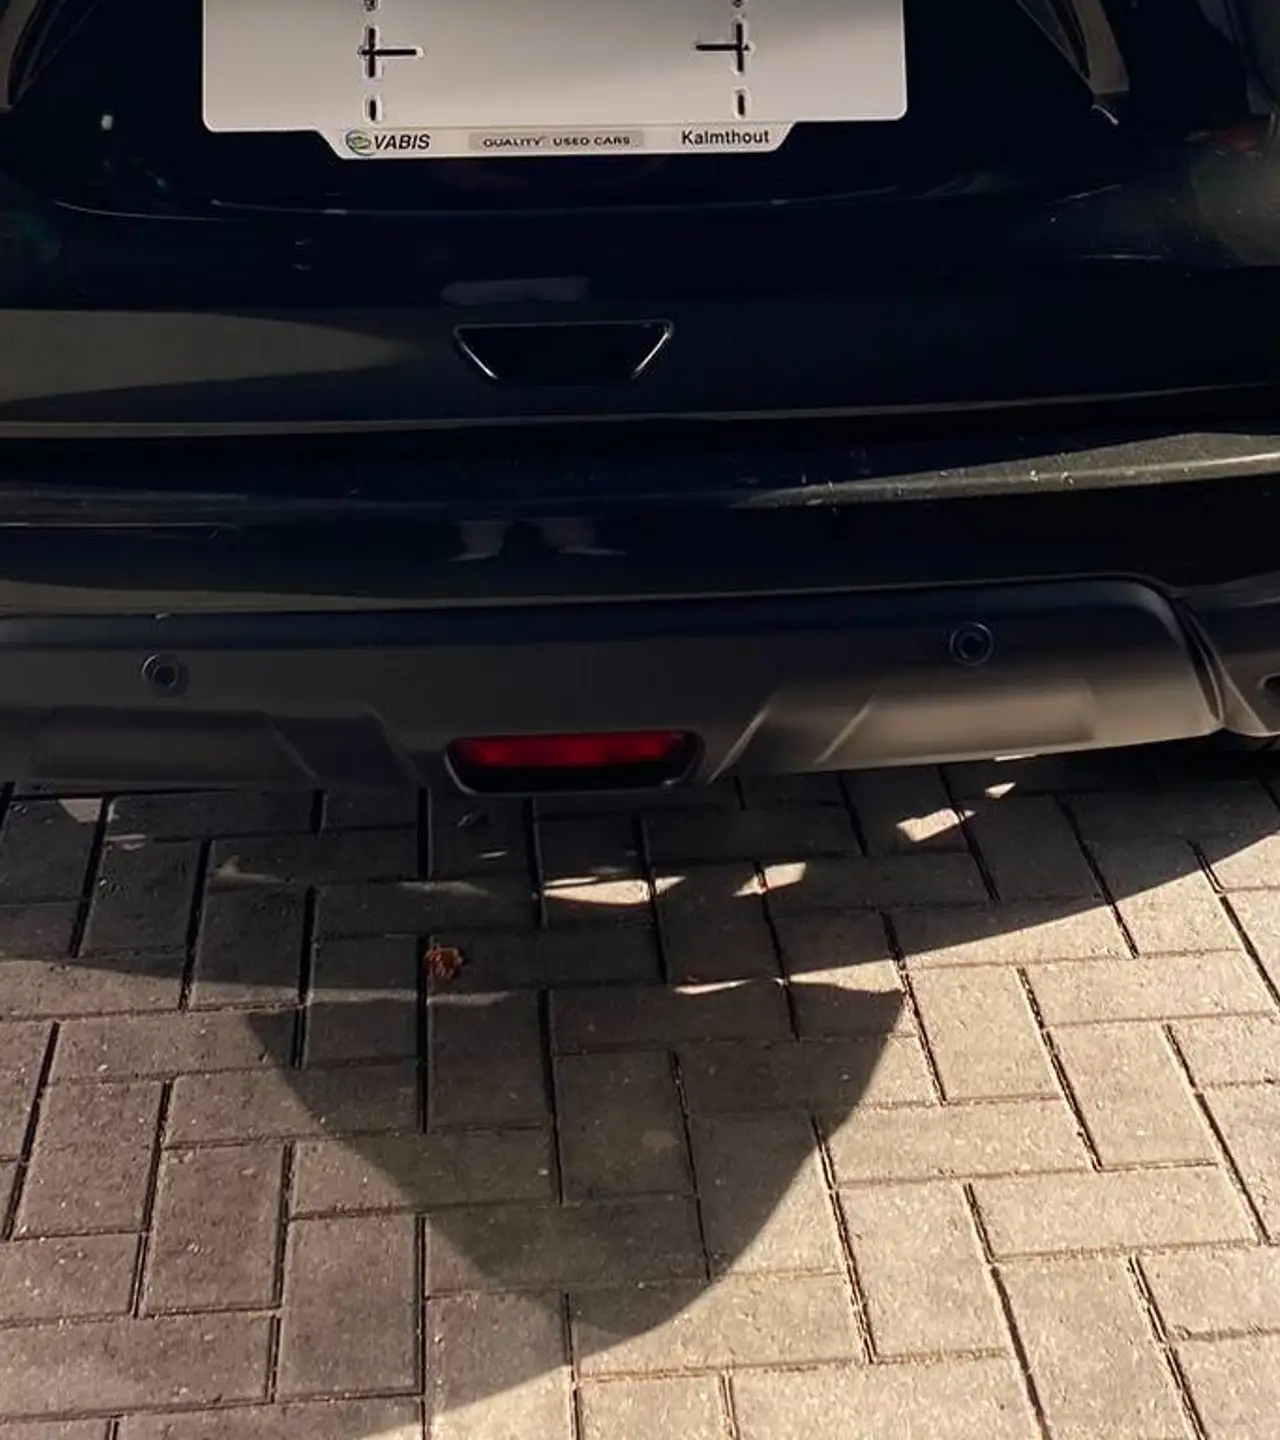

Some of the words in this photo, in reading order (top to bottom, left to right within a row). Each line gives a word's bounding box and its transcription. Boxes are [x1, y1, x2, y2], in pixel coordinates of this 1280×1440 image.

[374, 133, 431, 151] VABIS
[553, 136, 590, 147] USED
[593, 135, 631, 147] CARS
[681, 129, 770, 146] Kalmthout
